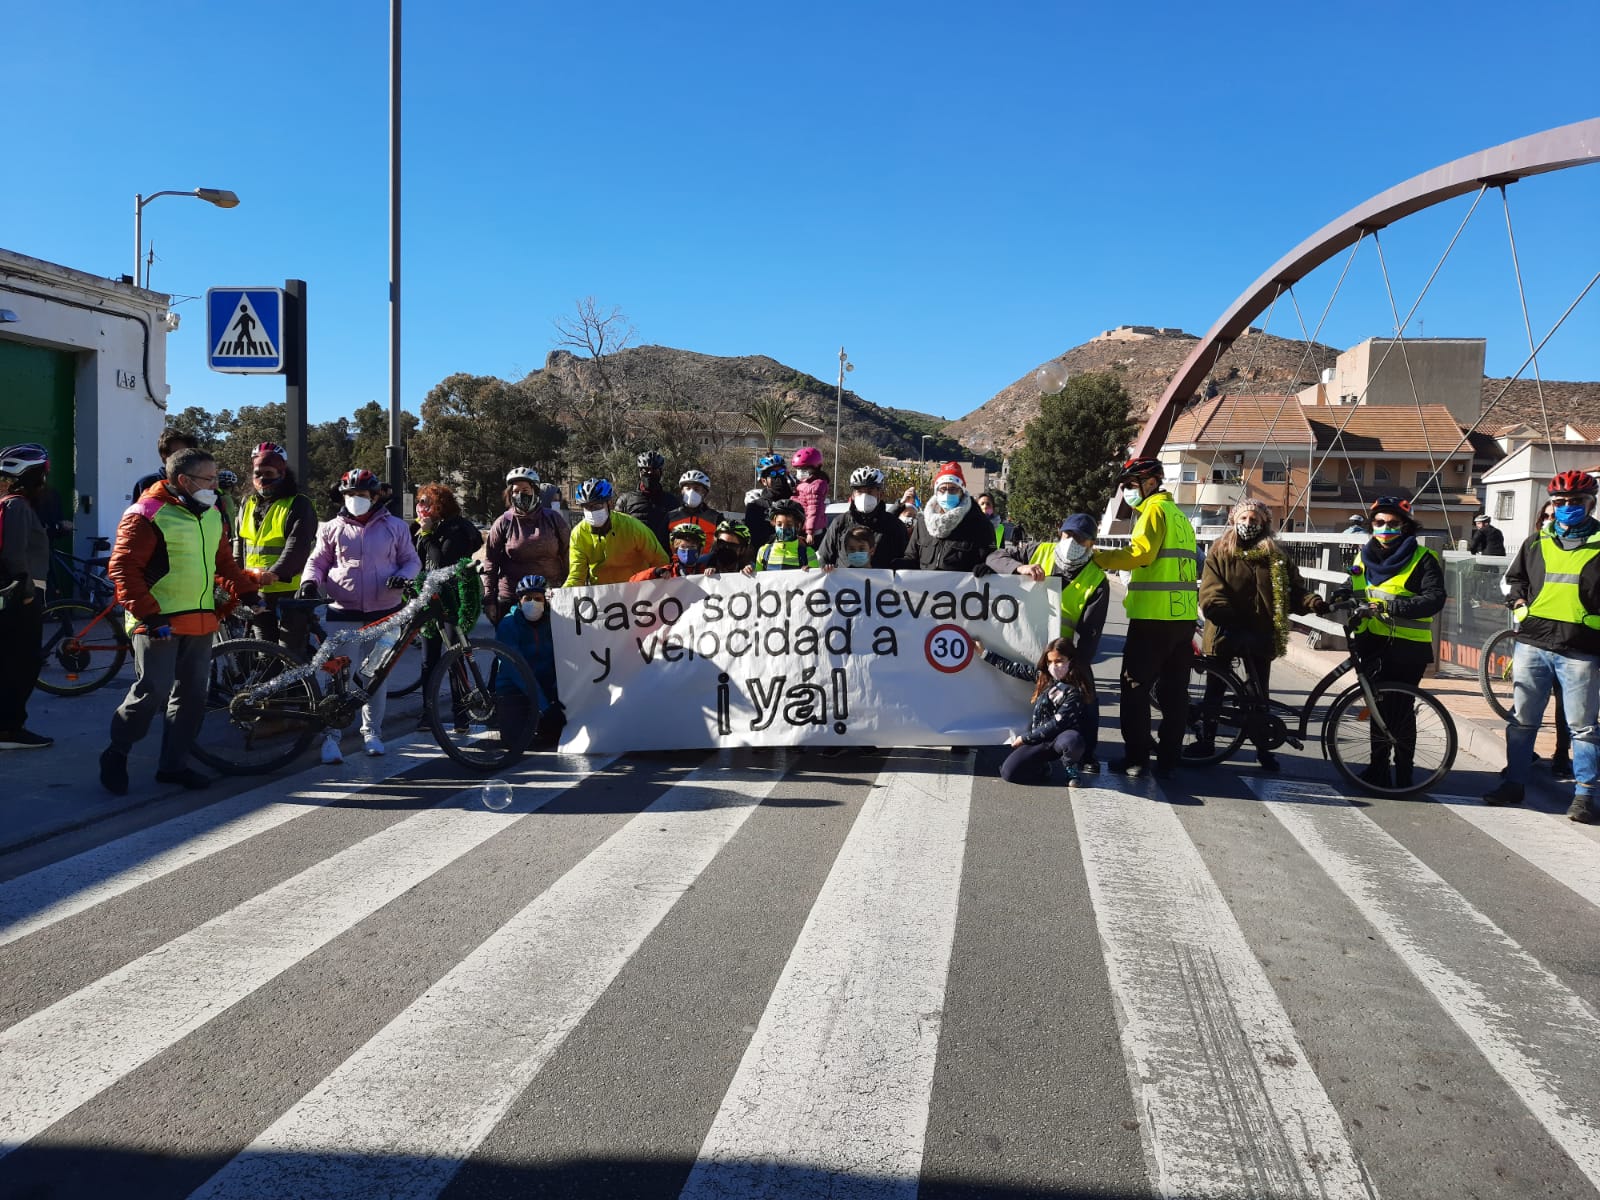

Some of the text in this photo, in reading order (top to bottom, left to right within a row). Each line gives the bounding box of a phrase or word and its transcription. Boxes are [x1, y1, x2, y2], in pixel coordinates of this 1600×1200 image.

[574, 578, 1019, 635] paso sobreelevado
[590, 618, 965, 683] y velocidad a 30
